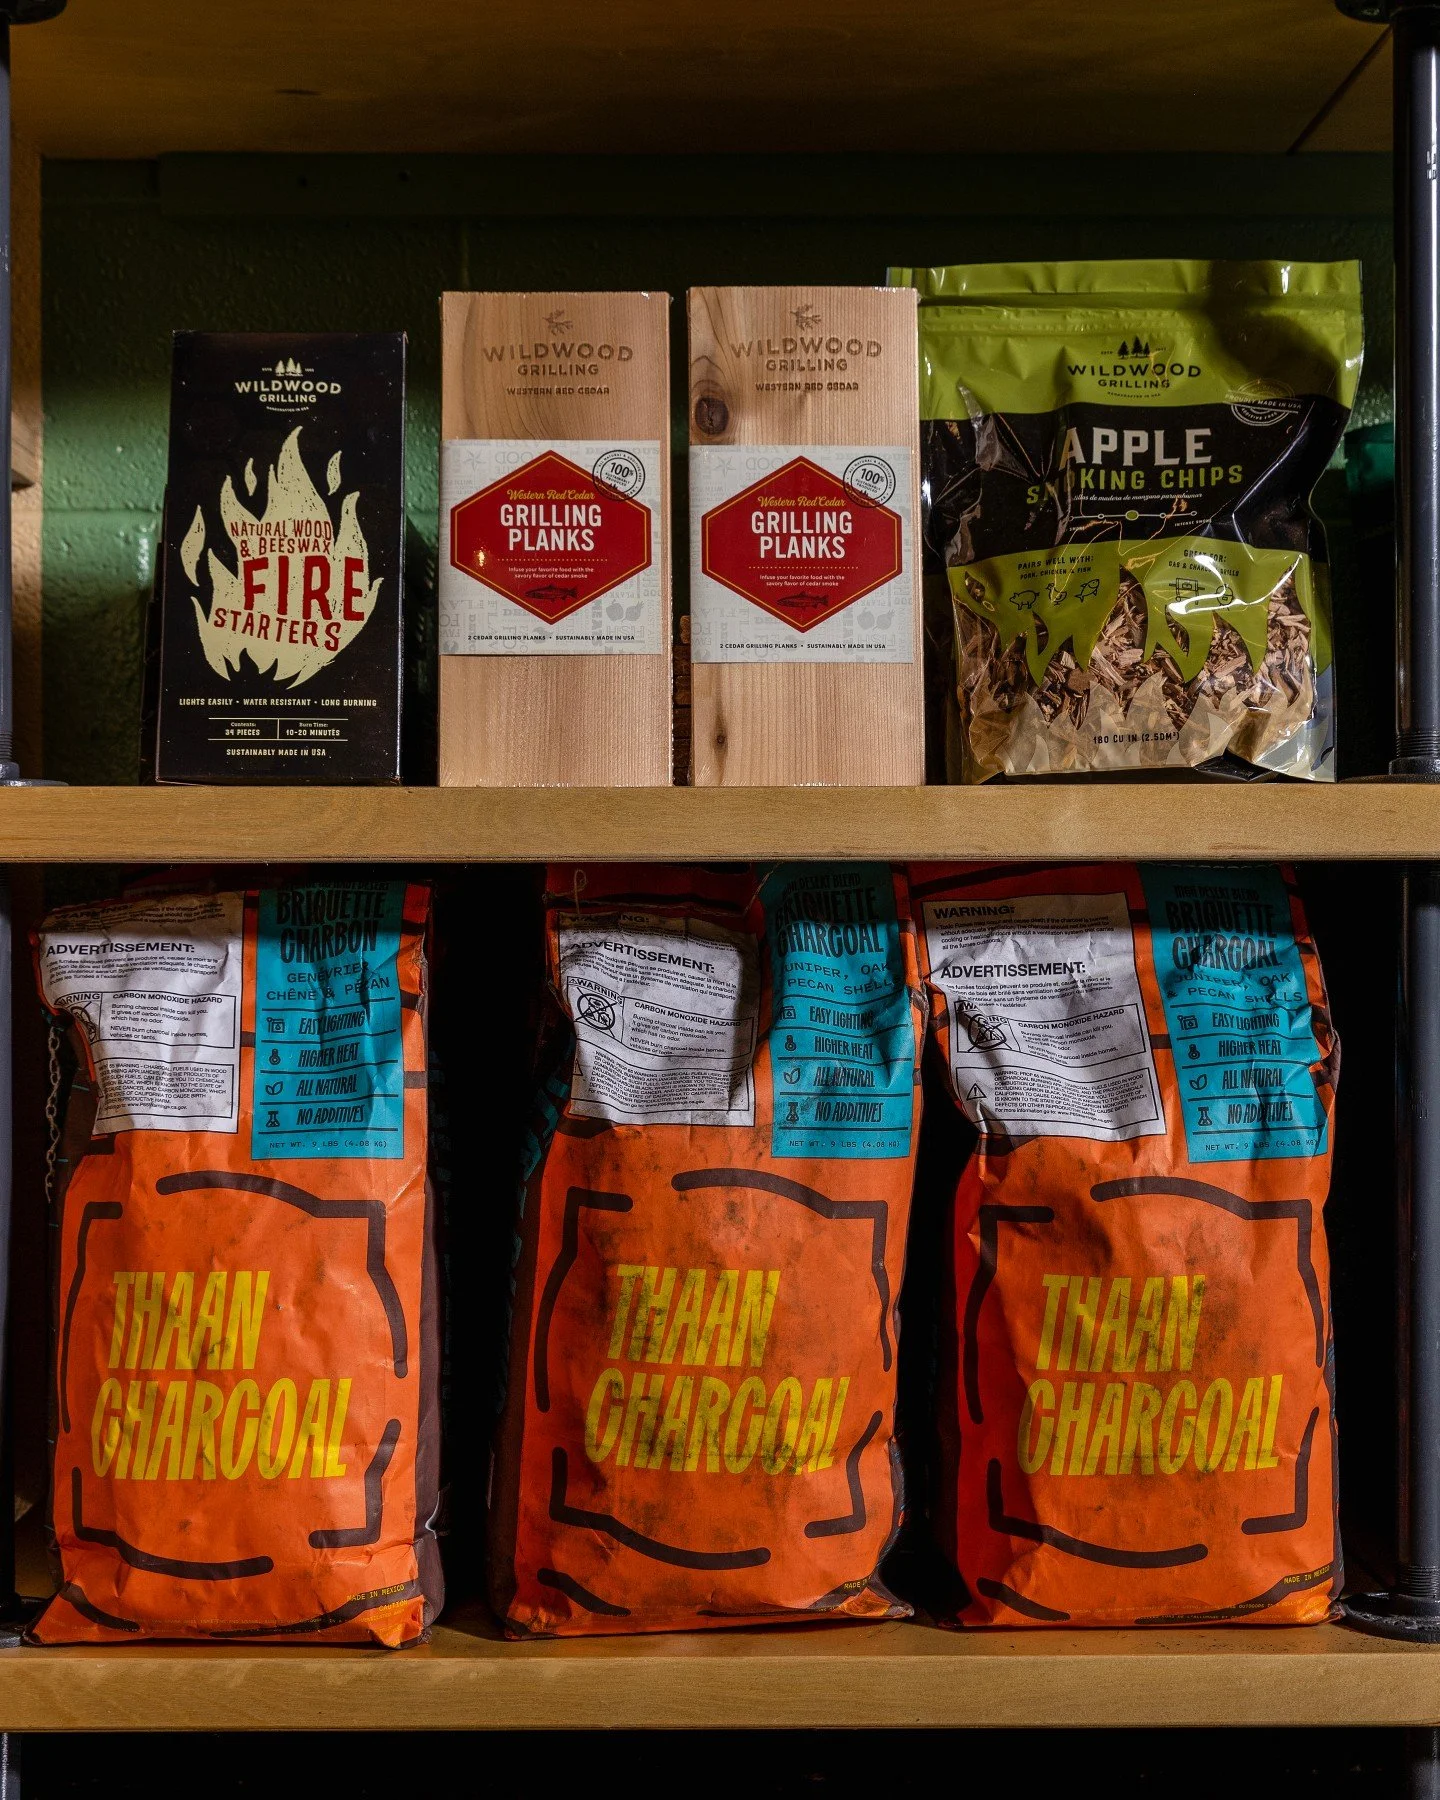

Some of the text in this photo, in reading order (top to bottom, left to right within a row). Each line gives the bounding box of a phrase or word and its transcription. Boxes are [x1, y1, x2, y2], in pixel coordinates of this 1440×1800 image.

[483, 342, 633, 362] WILDWOOD
[731, 337, 882, 358] WILDWOOD
[518, 364, 599, 376] GRILLING
[766, 358, 848, 371] GRILLING
[1067, 363, 1201, 377] WILDWOOD
[235, 380, 342, 395] WILDWOOD
[507, 386, 610, 395] WESTERN RED CEDAR
[756, 382, 859, 391] WESTERN RED CEDAR
[1098, 379, 1170, 388] GRILLING
[259, 394, 317, 403] GRILLING
[1059, 427, 1212, 471] APPLE
[610, 462, 633, 478] 100%
[861, 468, 885, 484] 100%
[1161, 464, 1244, 489] CHIPS
[507, 489, 595, 500] Western Red Cedar
[757, 496, 847, 507] Western Red Cedar
[500, 504, 602, 527] GRILLING
[751, 511, 853, 534] GRILLING
[230, 519, 332, 541] NATURAL WOOD
[240, 537, 331, 557] & BEESWAX
[509, 529, 595, 552] PLANKS
[760, 536, 846, 559] PLANKS
[1017, 555, 1094, 570] PAIRS WELL WITH:
[243, 555, 364, 621] FIRE
[213, 607, 342, 652] STARTERS
[179, 698, 205, 706] LIGHTS
[207, 698, 233, 706] EASILY
[243, 698, 268, 706] WATER
[270, 698, 311, 706] RESISTANT
[343, 699, 377, 707] BURNING
[1093, 735, 1109, 744] 180
[1113, 734, 1124, 743] CU
[1128, 733, 1138, 742] IN
[226, 748, 275, 756] SUSTAINABLY
[311, 748, 326, 756] USA
[275, 888, 384, 927] BRIQUETTE
[933, 905, 1016, 920] WARNING:
[1164, 901, 1278, 938] BRIQUETTE
[46, 942, 195, 958] ADVERTISSEMENT:
[280, 919, 378, 965] CHARBON
[778, 922, 885, 958] CHARCOAL
[570, 941, 715, 974] ADVERTISSEMENT:
[1172, 932, 1283, 973] CHARCOAL
[287, 961, 370, 984] GENÉVRIER
[785, 963, 849, 980] UNIPER,
[940, 961, 1086, 979] ADVERTISSEMENT:
[787, 978, 835, 993] PECAN
[1173, 972, 1292, 990] JUNIPER, OAK
[112, 992, 223, 1005] CARBON MONOXIDE HAZARD
[266, 987, 317, 1000] CHÊNE
[1166, 987, 1304, 1004] & PECAN SHELLS
[298, 1010, 365, 1035] EASY LIGHTING
[634, 1001, 666, 1015] CARBON
[667, 1010, 708, 1024] MONOXIDE
[809, 1006, 874, 1030] EASY LIGHTING
[1018, 1008, 1125, 1030] CARBON MONOXIDE HAZARD
[1212, 1012, 1280, 1030] EASY LIGHTING
[298, 1041, 360, 1067] HIGHER HEAT
[814, 1035, 874, 1060] HIGHER HEAT
[1218, 1039, 1282, 1058] HIGHER HEAT
[296, 1074, 358, 1097] ALL NATURAL
[813, 1066, 876, 1088] ALL NATURAL
[1221, 1067, 1285, 1090] ALL NATURAL
[296, 1105, 365, 1125] NO ADDITIVES
[814, 1101, 884, 1123] NO ADDITIVES
[1227, 1101, 1293, 1125] NO ADDITIVES
[789, 1140, 805, 1148] NET
[862, 1140, 886, 1149] (4.08
[107, 1270, 270, 1370] THAAN
[607, 1264, 781, 1368] THAAN
[1035, 1273, 1206, 1373] THAAN
[91, 1377, 353, 1481] CHARCOAL
[584, 1367, 851, 1476] CHARCOAL
[1016, 1374, 1284, 1476] CHARCOAL
[844, 1581, 860, 1589] MADE
[1283, 1566, 1330, 1584] MADE IN MEXICO
[369, 1590, 378, 1599] IN
[381, 1584, 405, 1596] MEXICO
